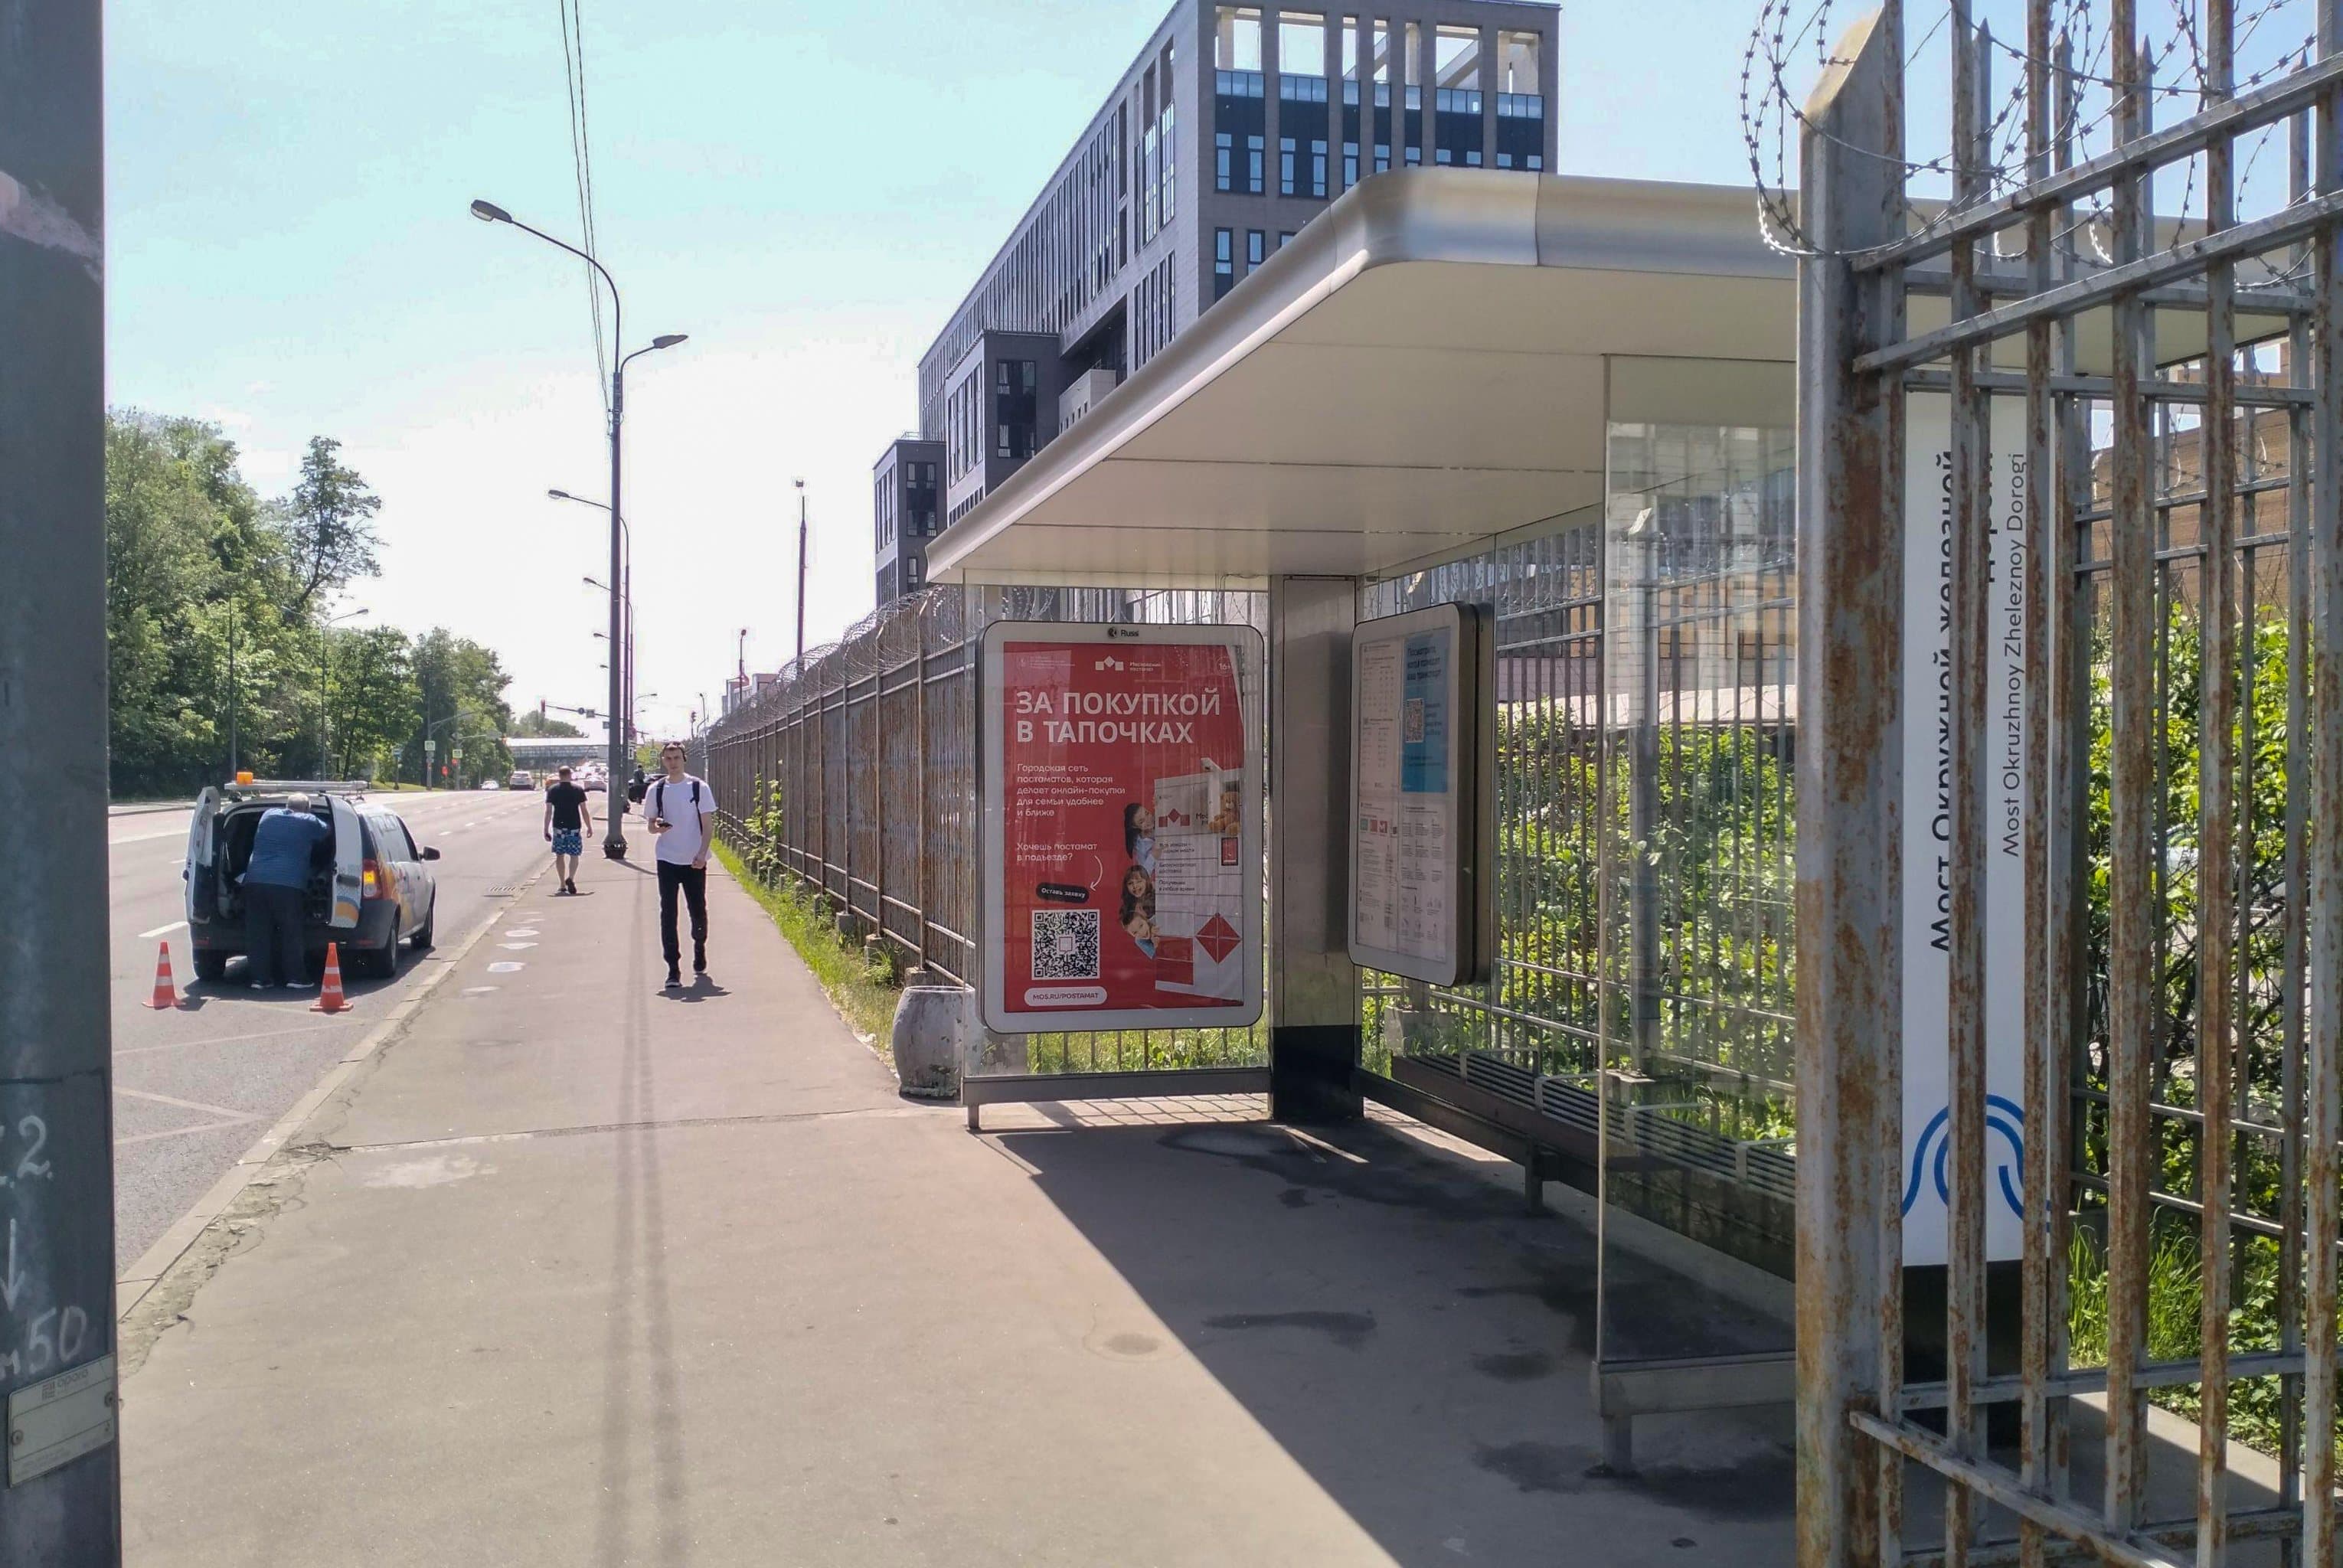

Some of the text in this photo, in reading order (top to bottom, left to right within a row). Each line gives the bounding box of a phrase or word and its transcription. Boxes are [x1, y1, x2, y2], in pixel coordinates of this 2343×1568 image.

[2002, 453, 2028, 858] Most Okruzhnoy Zheleznoy Dorogi
[1016, 688, 1220, 715] ЗА ПОКУПКОЙ
[1017, 720, 1193, 743] В ТАПОЧКАХ
[1017, 763, 1066, 773] Городская
[1017, 786, 1126, 795] делает онлайн-покупки
[1017, 798, 1034, 806] для
[1066, 797, 1104, 806] удобнее
[1025, 808, 1055, 817] ближе
[1017, 843, 1052, 851] Хочешь
[1024, 853, 1073, 863] подъезде?
[1041, 887, 1064, 896] Оставь
[1032, 992, 1099, 1001] MOS.RU/POSTAMAT
